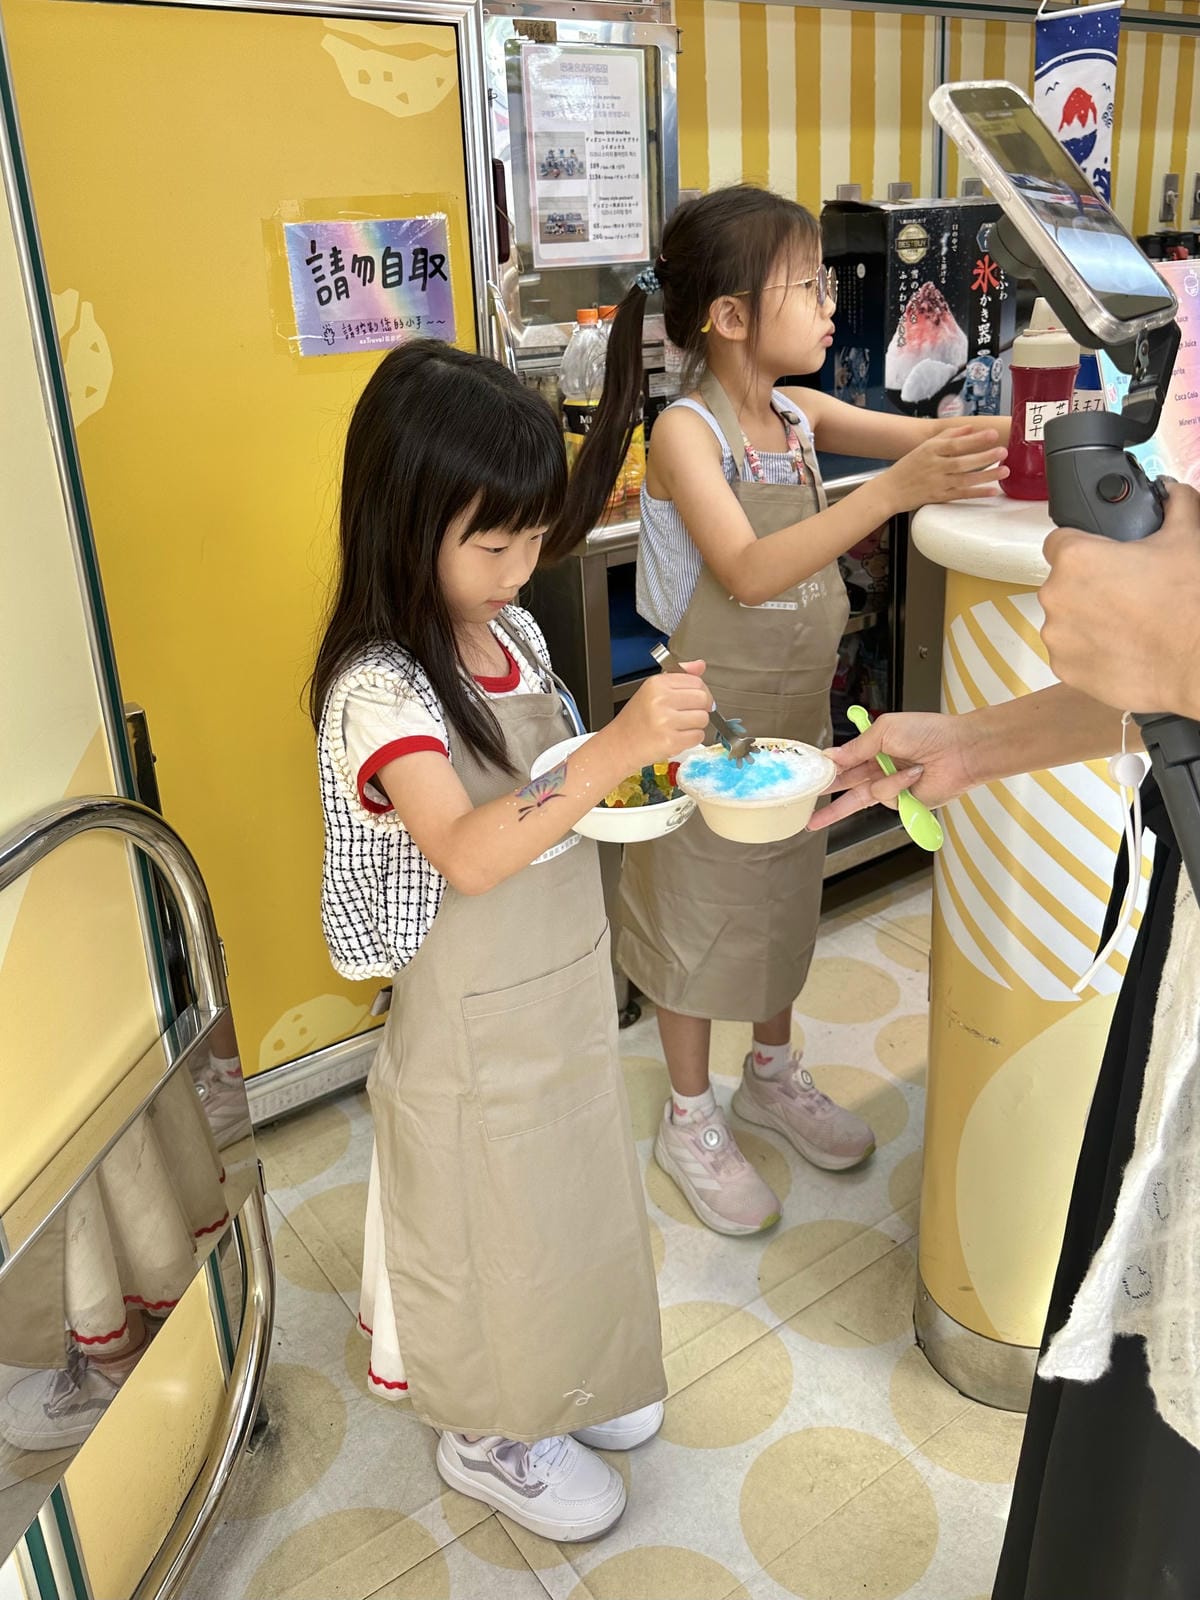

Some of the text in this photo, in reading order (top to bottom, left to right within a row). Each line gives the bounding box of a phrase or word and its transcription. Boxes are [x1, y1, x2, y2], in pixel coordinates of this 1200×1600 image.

[306, 240, 448, 306] 請勿自取
[1172, 367, 1186, 377] prite
[1174, 391, 1199, 402] Coca Cola
[1179, 416, 1197, 427] Mineral
